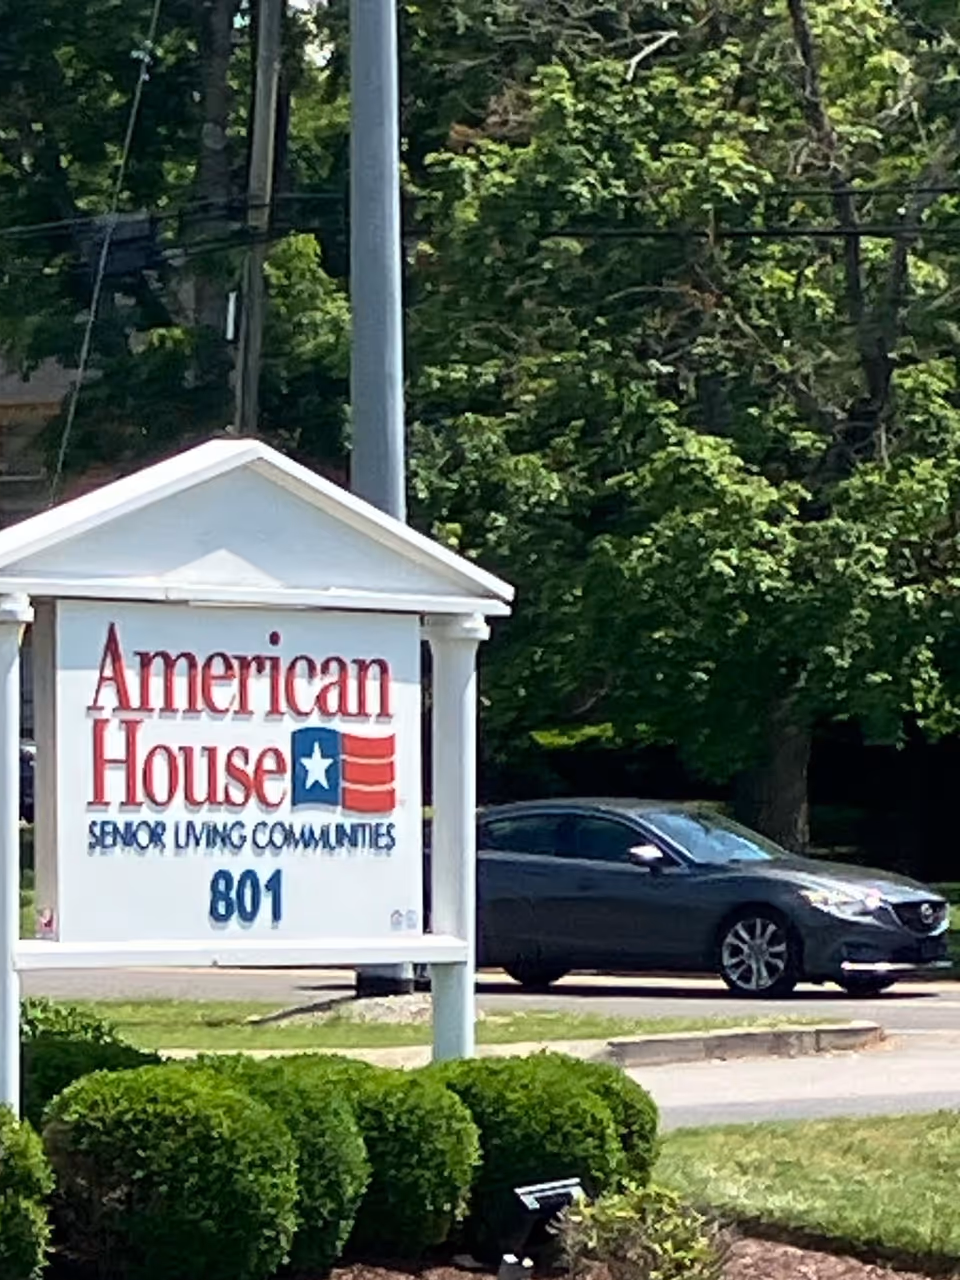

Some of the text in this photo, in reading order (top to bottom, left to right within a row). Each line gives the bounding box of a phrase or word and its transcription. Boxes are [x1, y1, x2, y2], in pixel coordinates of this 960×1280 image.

[87, 622, 393, 718] American
[87, 718, 287, 808] House
[88, 821, 396, 850] SENIOR LIVING COMMUNITIES
[209, 869, 283, 923] 801
